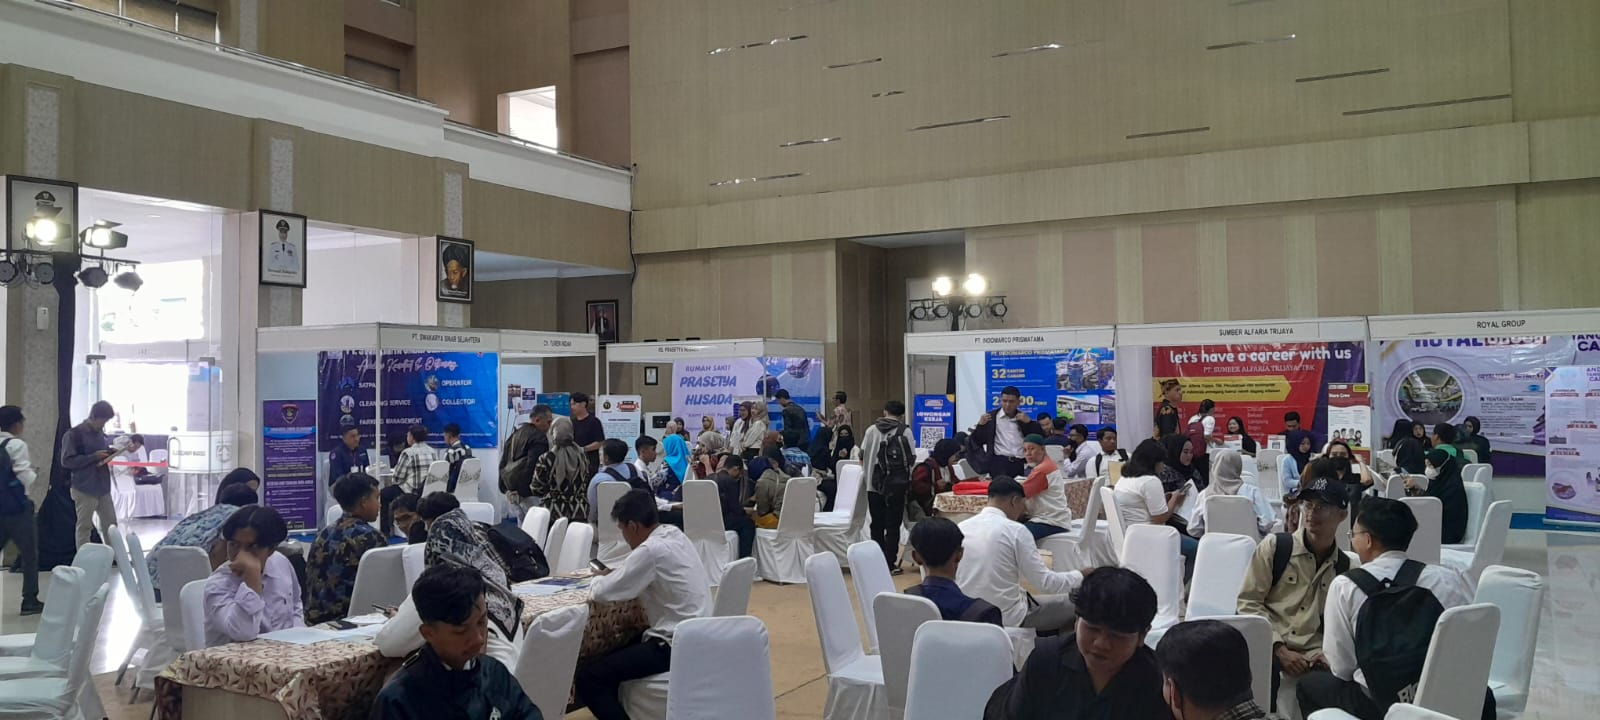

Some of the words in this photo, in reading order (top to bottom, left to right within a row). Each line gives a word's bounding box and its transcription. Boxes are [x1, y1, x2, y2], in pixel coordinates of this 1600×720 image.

[1477, 321, 1499, 329] ROYAL
[1501, 320, 1526, 328] GROUP
[1219, 328, 1242, 336] SUMBER
[1170, 350, 1198, 364] let's
[1201, 350, 1234, 363] have
[1238, 353, 1247, 362] a
[1250, 350, 1296, 362] career
[1300, 347, 1331, 360] with
[1335, 349, 1352, 360] us
[991, 368, 1007, 379] 32
[680, 375, 737, 387] PRASETYA
[441, 398, 476, 406] COLLECTOR
[685, 394, 733, 405] HUSADA
